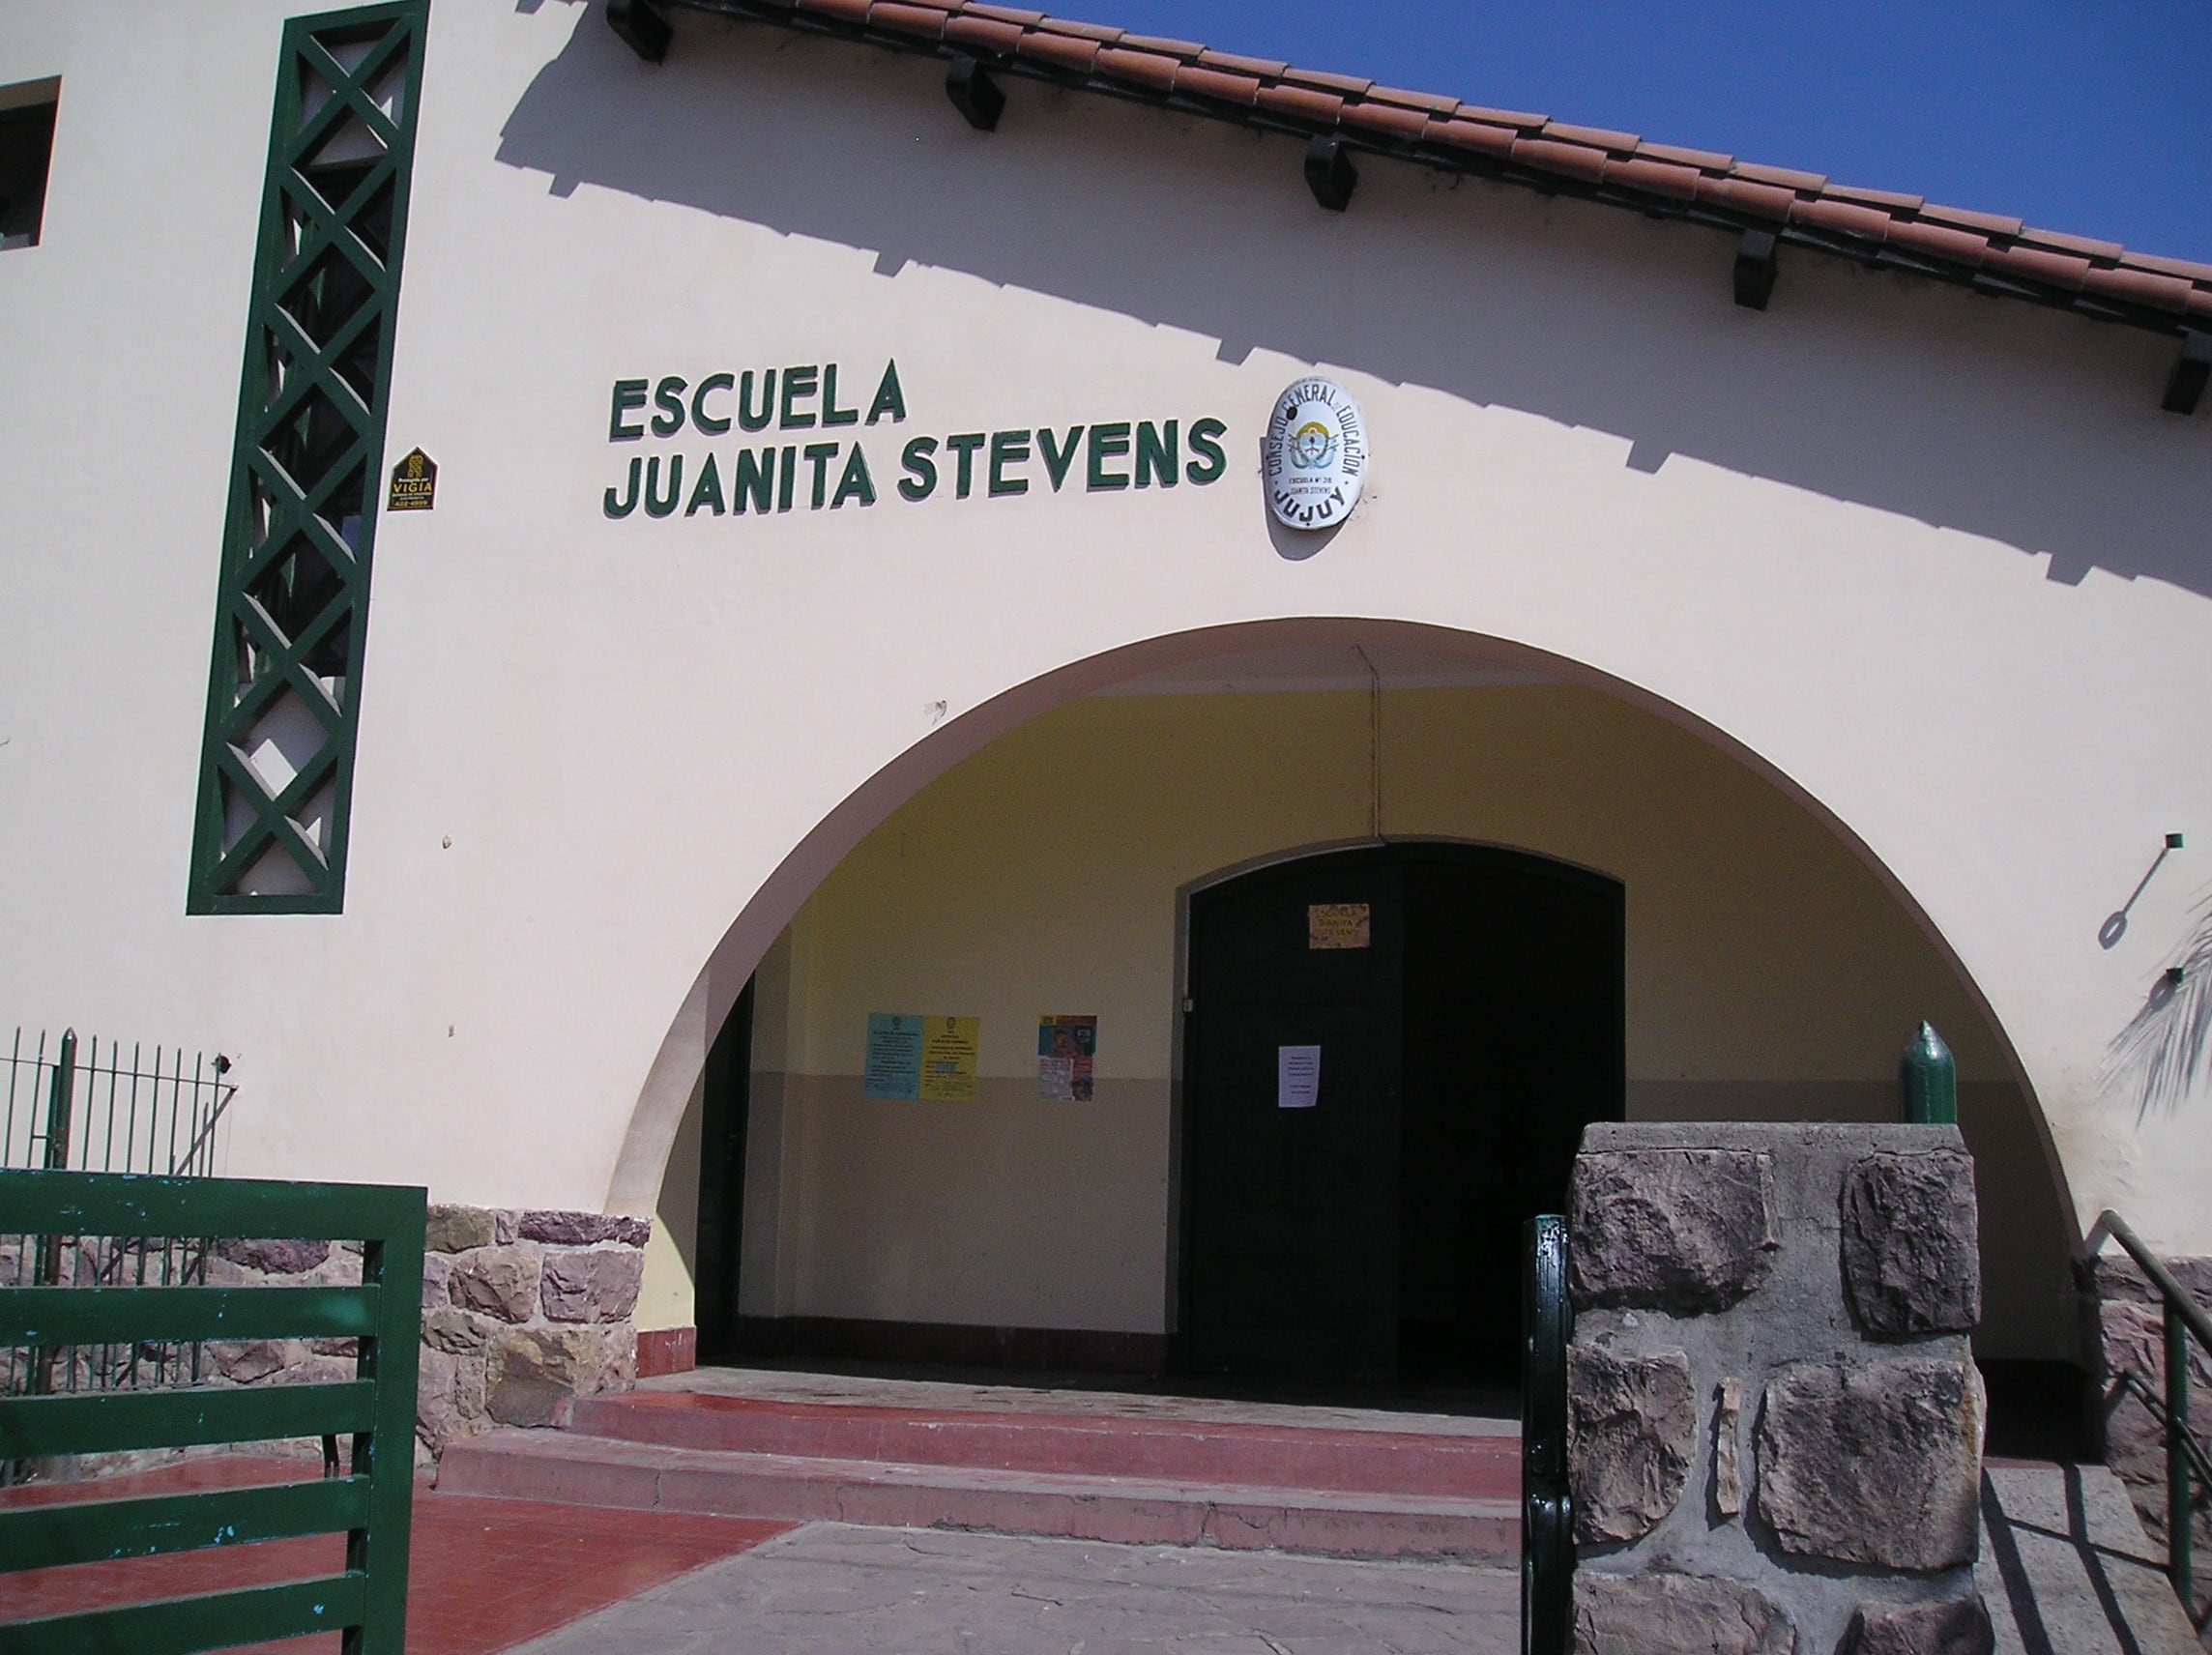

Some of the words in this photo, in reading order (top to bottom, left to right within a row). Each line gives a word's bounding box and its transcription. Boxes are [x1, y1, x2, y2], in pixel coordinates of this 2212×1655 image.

[609, 358, 907, 442] ESCUELA
[1268, 416, 1289, 477] CONSEJO
[1281, 384, 1336, 412] GENERAL
[1336, 405, 1362, 477] EDUCACION
[393, 482, 432, 494] VIGIA
[602, 442, 876, 520] JUANITA
[897, 418, 1228, 503] STEVENS
[1273, 485, 1345, 522] JUJUY
